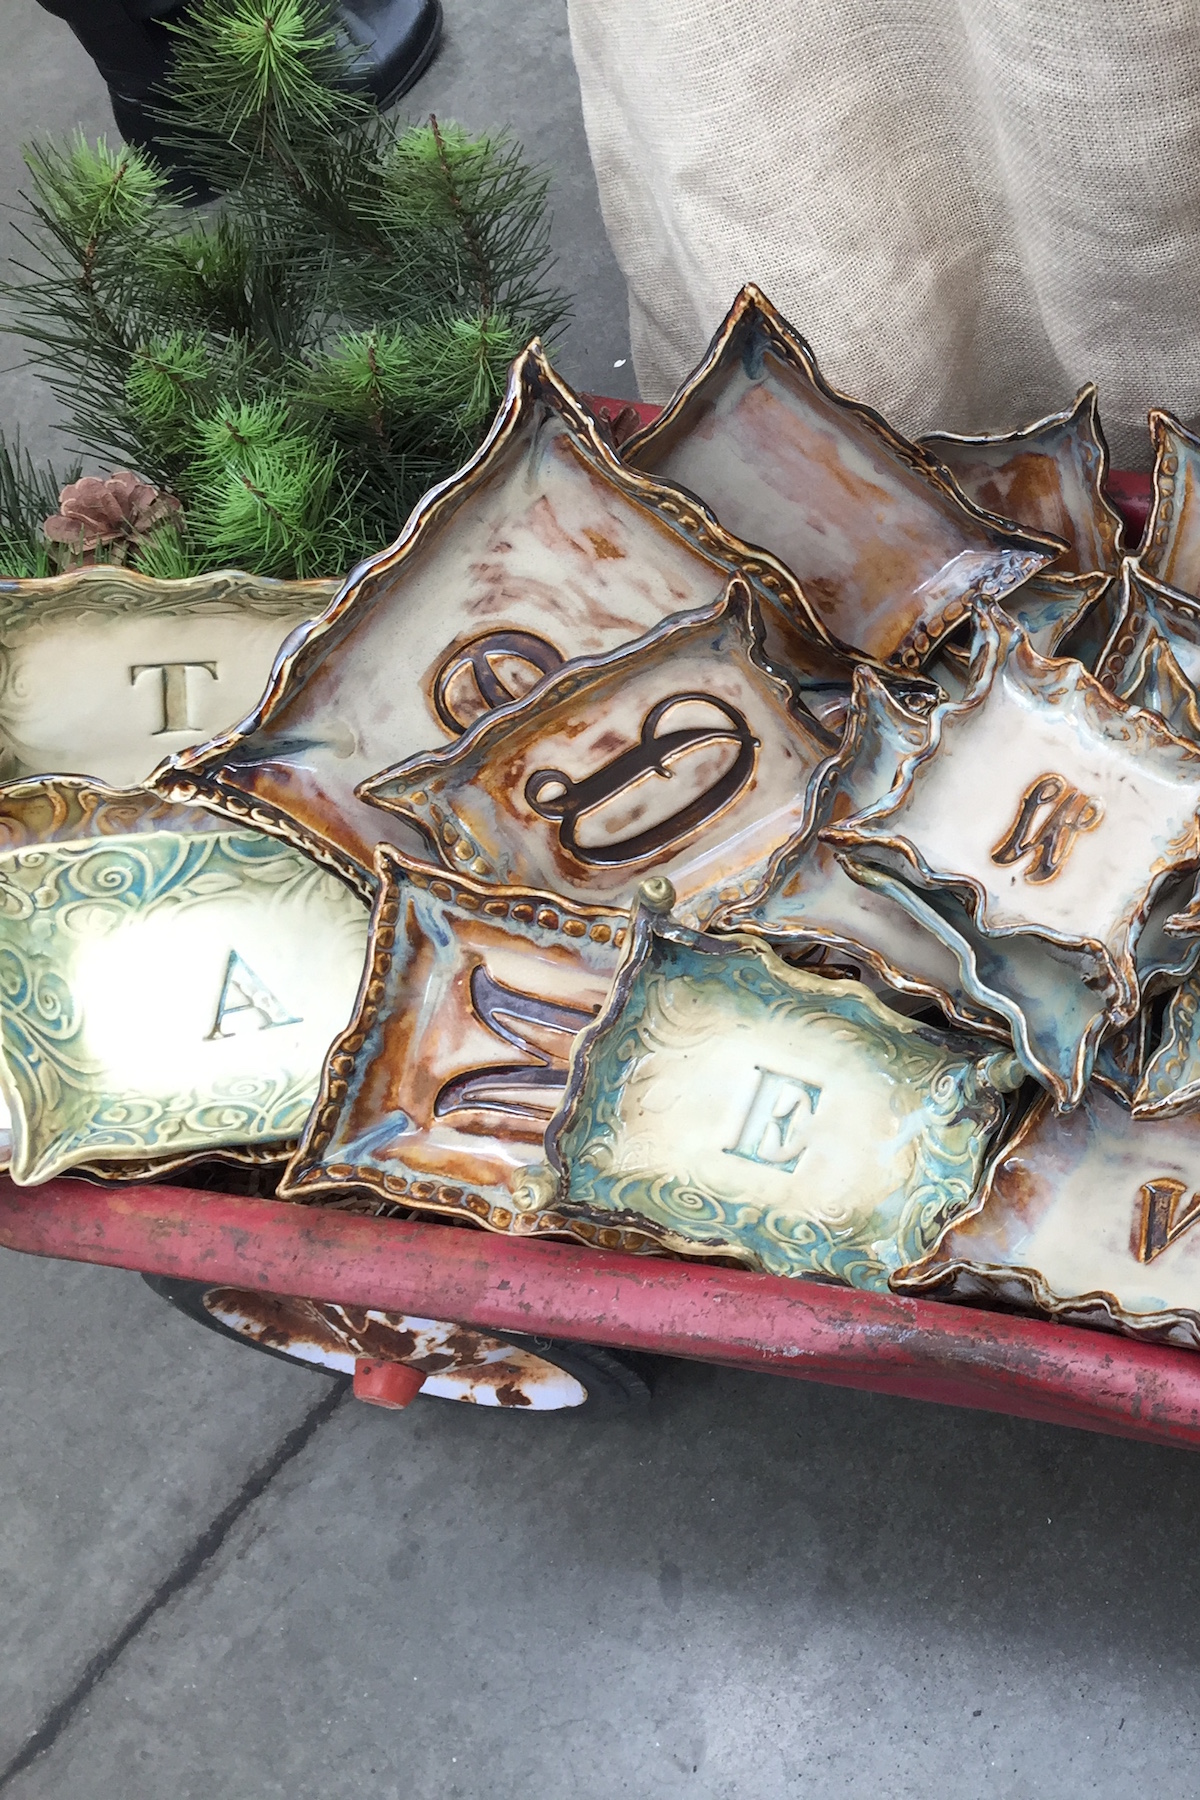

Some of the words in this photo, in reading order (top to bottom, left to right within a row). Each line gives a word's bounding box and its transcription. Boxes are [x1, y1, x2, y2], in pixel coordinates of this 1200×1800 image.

[129, 660, 220, 736] T
[202, 948, 304, 1042] A
[721, 1065, 824, 1174] E
